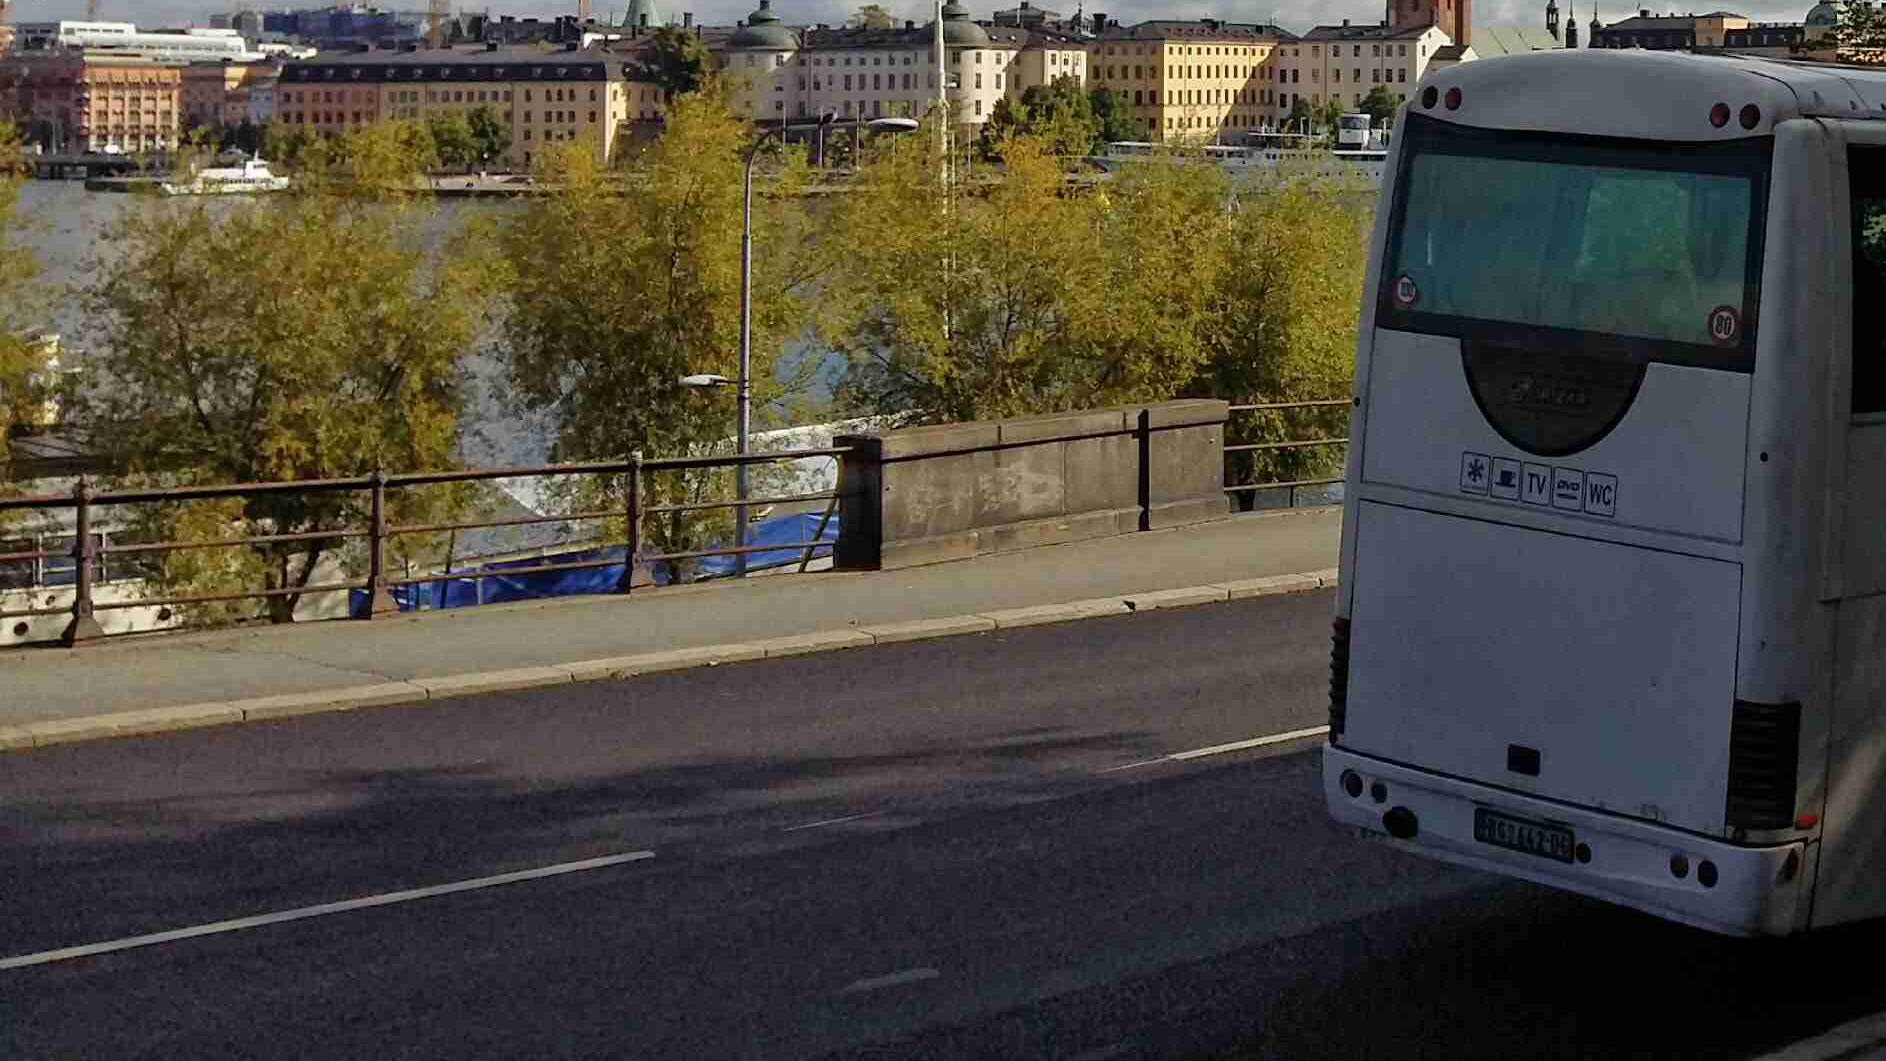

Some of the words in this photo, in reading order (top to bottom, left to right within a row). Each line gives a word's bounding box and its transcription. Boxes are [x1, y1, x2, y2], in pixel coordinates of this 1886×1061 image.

[1715, 315, 1732, 335] 80
[1527, 472, 1547, 495] TV
[1590, 482, 1613, 506] WC
